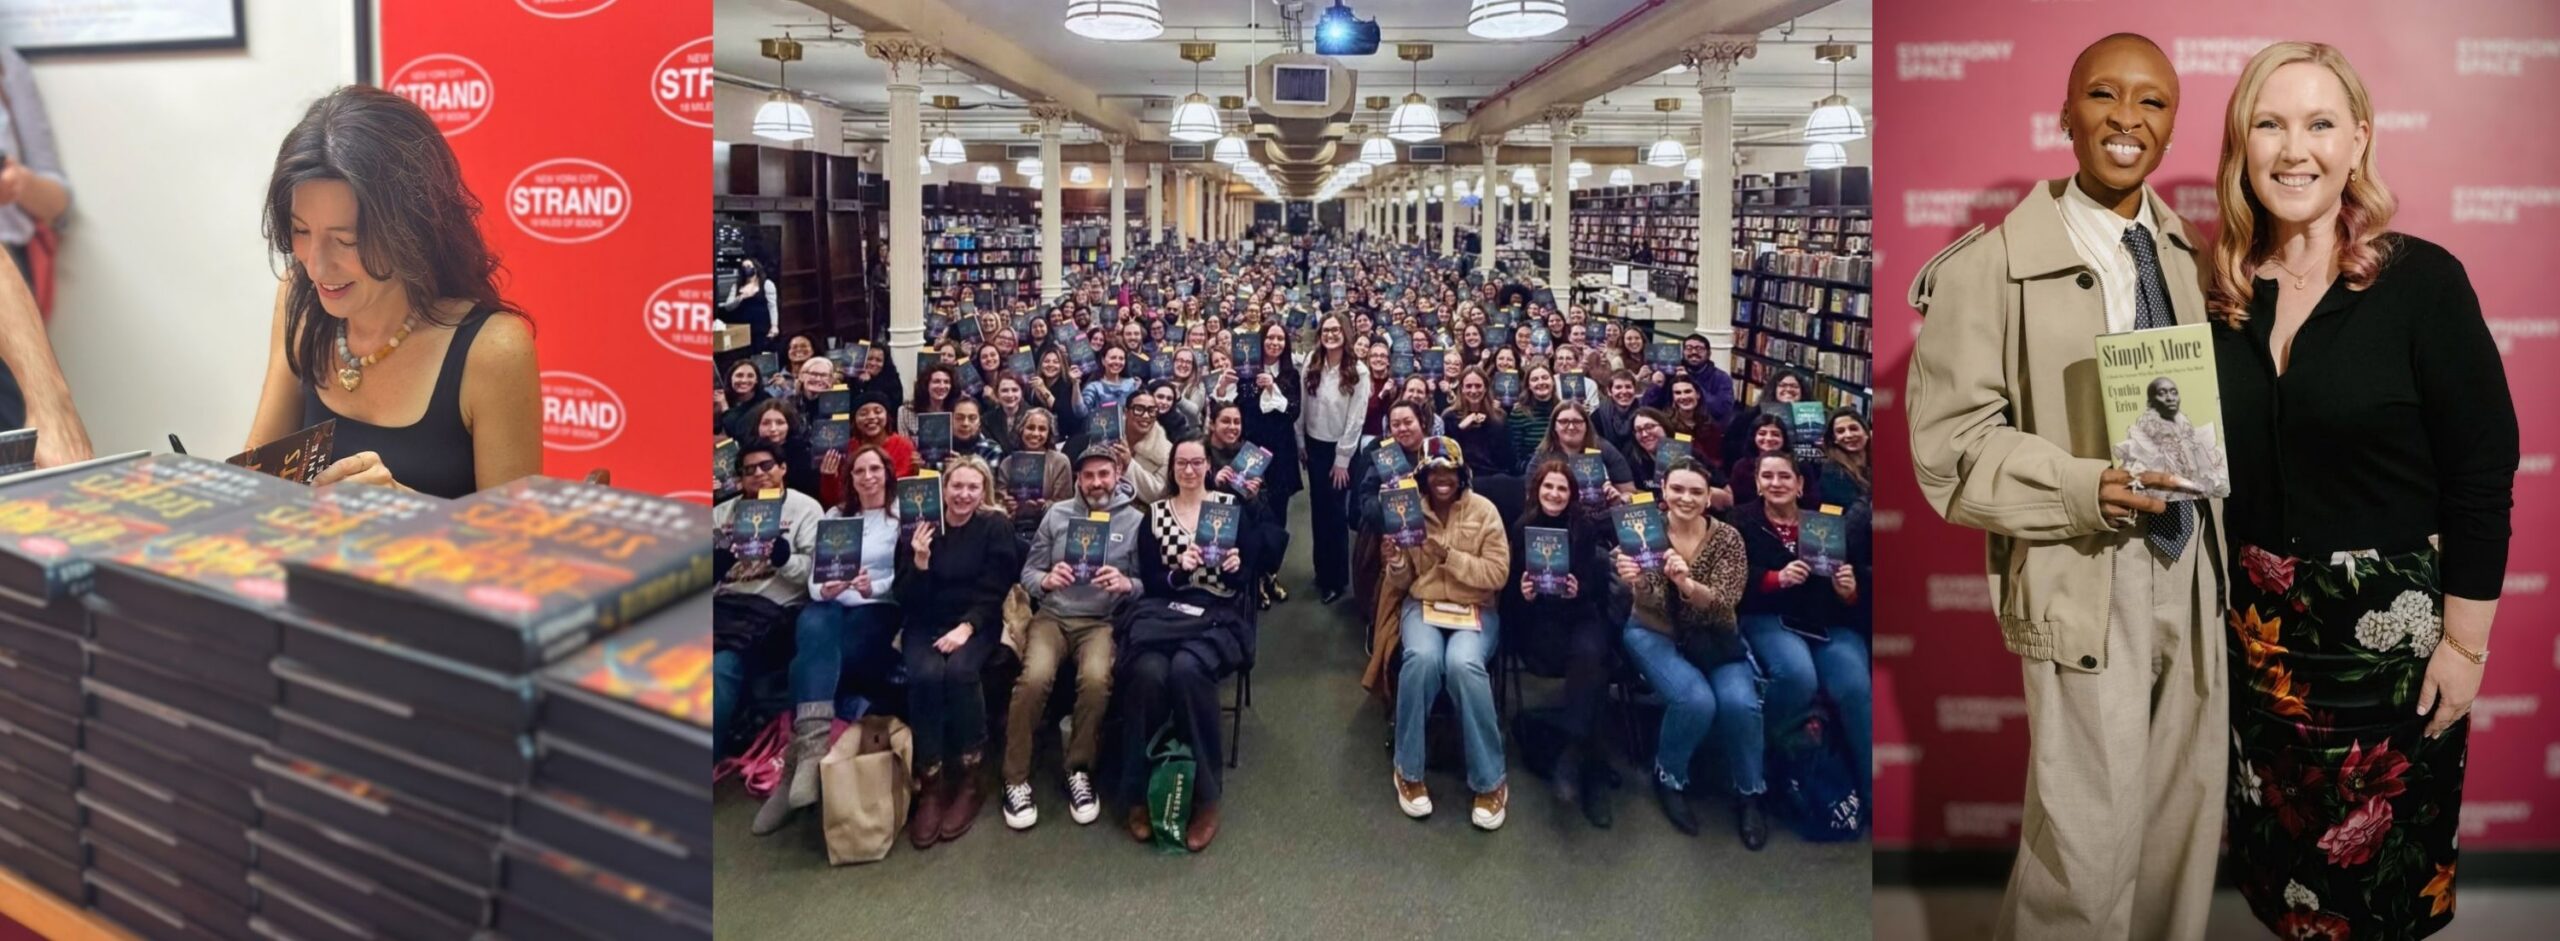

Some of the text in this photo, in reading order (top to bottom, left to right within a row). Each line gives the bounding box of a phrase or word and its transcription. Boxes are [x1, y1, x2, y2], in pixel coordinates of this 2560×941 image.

[660, 67, 713, 100] STR
[691, 101, 713, 112] MILE
[513, 186, 623, 216] STRAND
[652, 300, 711, 331] STR
[2102, 338, 2202, 370] Simply More
[2108, 384, 2141, 399] Cynthia
[2115, 400, 2138, 413] Erivo
[543, 396, 618, 430] RAND
[1624, 510, 1648, 519] ALICE
